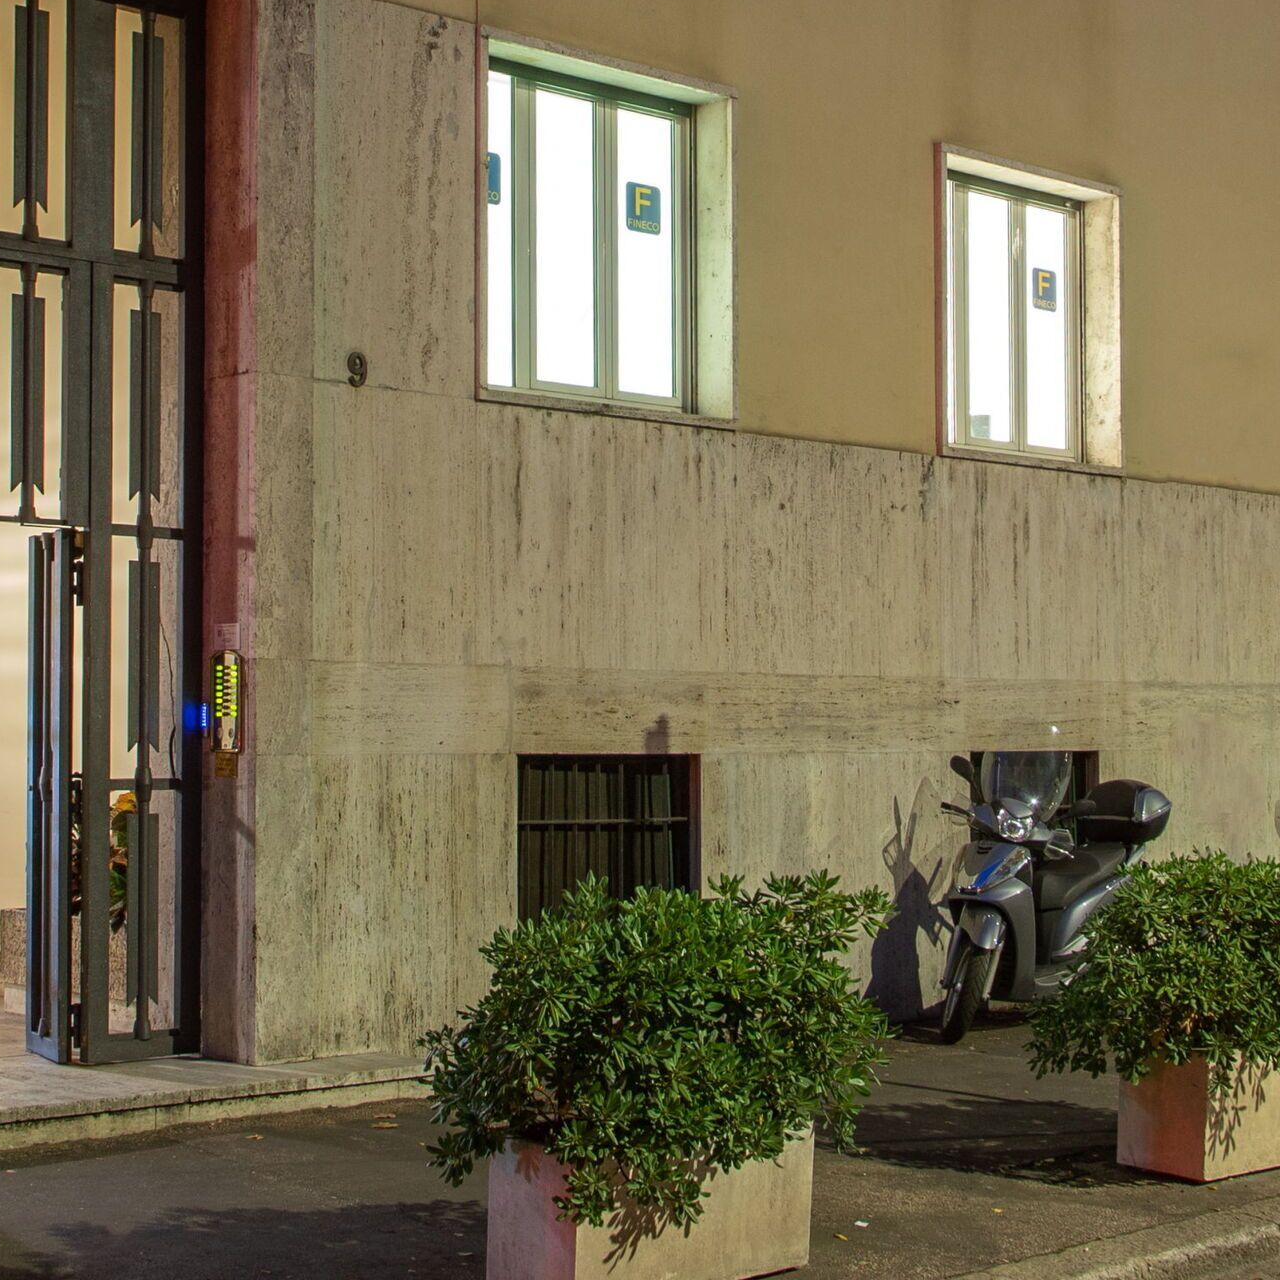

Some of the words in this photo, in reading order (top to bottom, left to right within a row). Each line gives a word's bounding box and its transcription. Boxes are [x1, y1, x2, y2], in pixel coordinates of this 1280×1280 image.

[635, 187, 652, 216] F
[627, 217, 660, 232] FINECO
[1038, 271, 1050, 297] F
